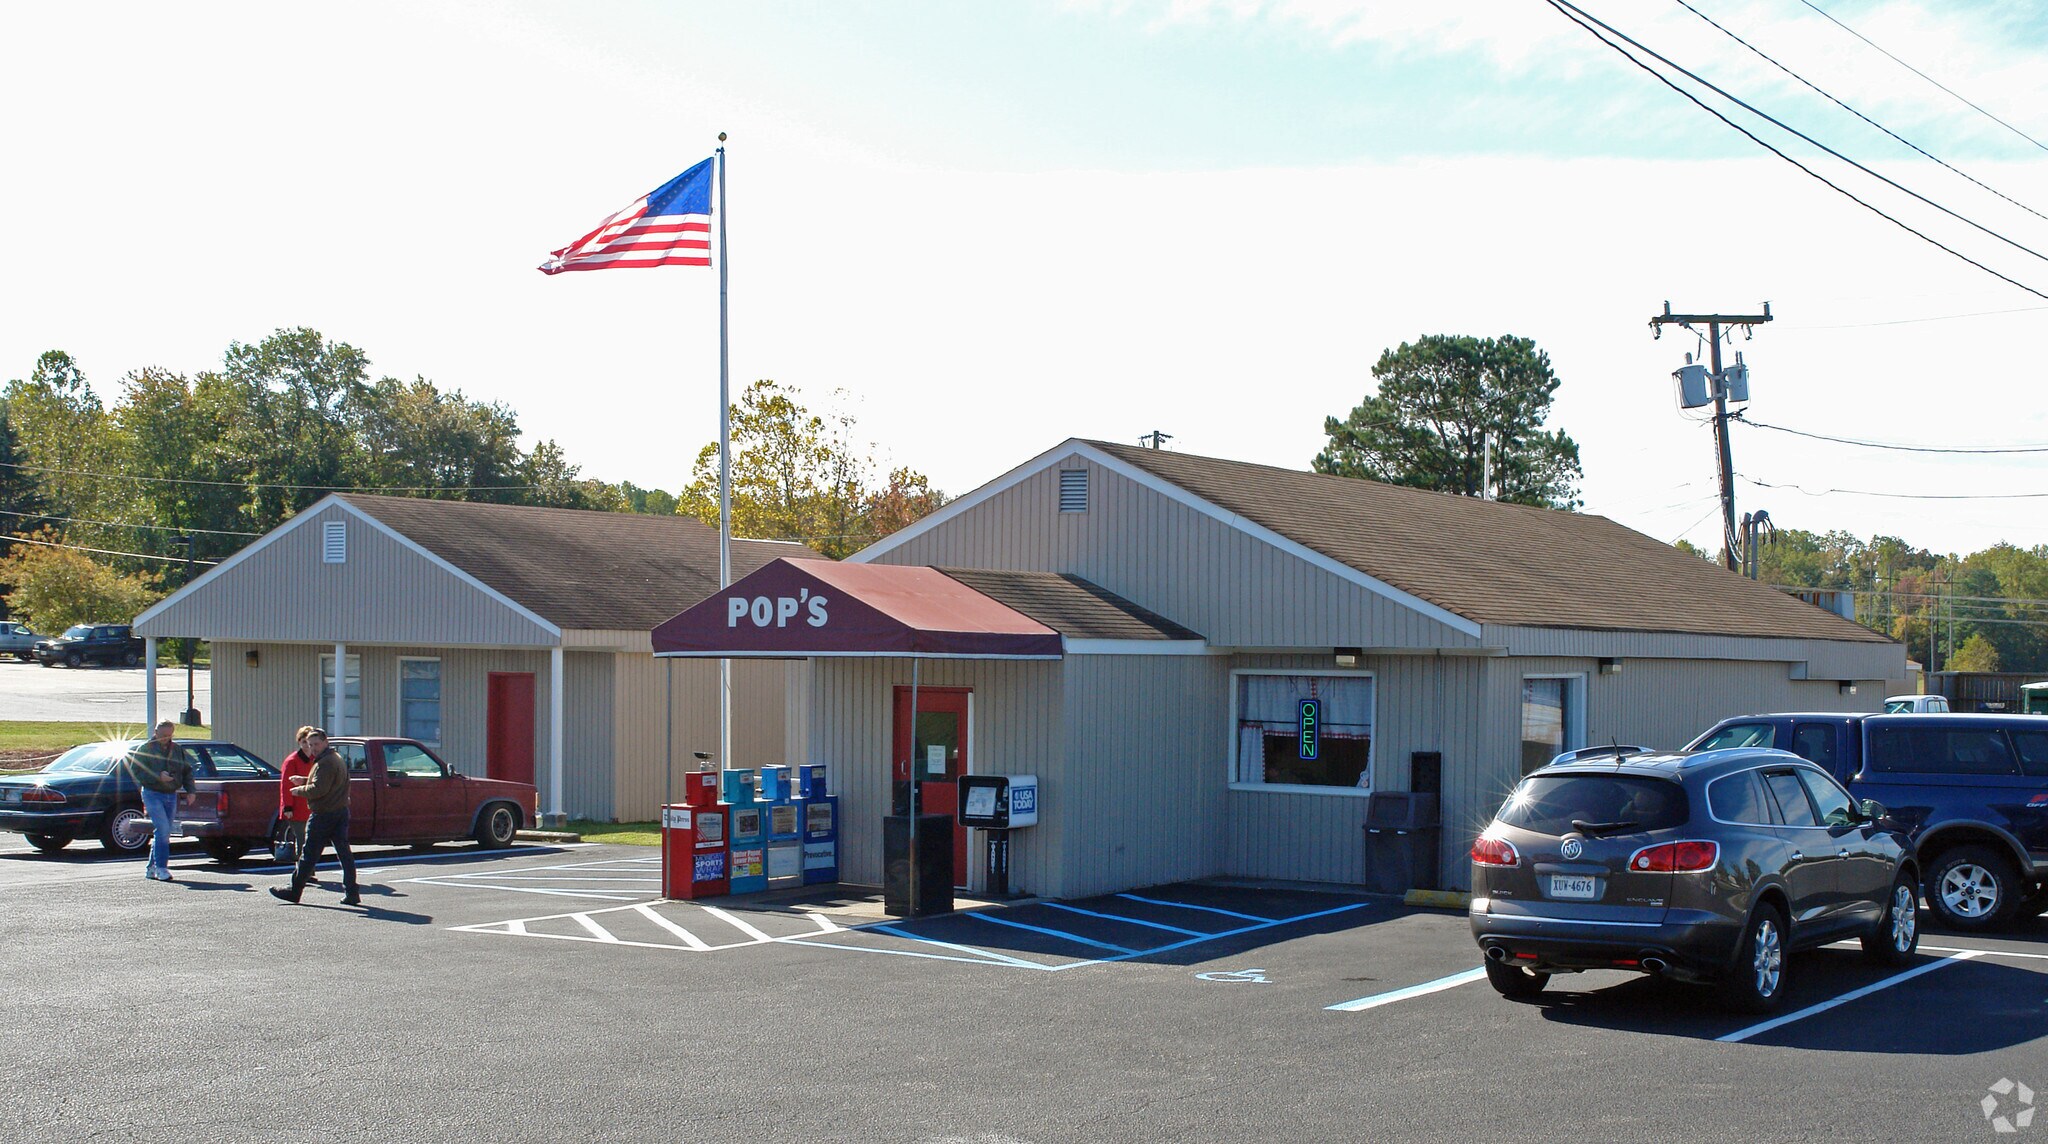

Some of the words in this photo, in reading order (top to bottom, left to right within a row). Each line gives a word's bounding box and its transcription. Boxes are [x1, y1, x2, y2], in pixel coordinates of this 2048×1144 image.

[728, 588, 828, 627] POP'S
[1303, 703, 1315, 756] OPEN
[1020, 790, 1033, 800] USA
[1013, 799, 1034, 810] TODAY
[695, 859, 723, 868] SPORTS
[696, 866, 723, 874] WRAP
[1553, 879, 1592, 891] XUW-4676
